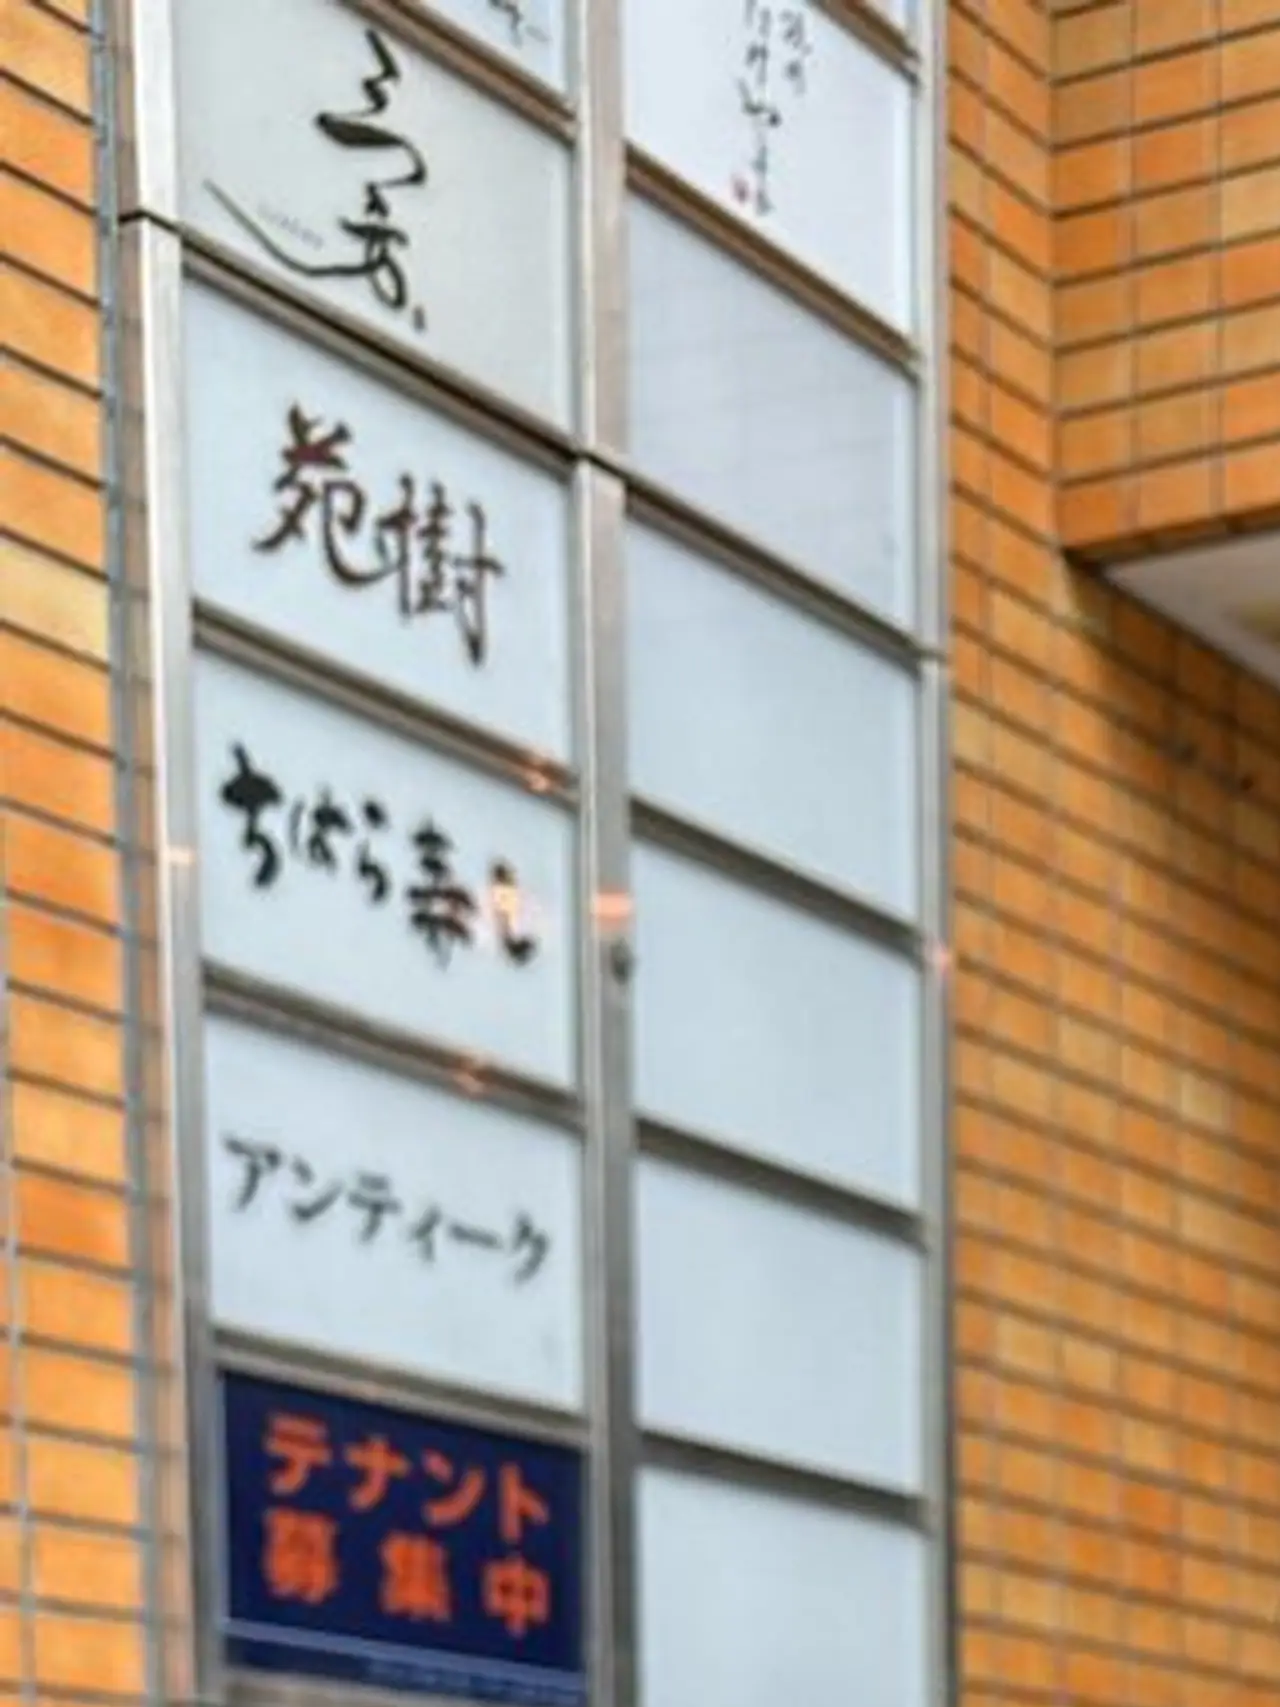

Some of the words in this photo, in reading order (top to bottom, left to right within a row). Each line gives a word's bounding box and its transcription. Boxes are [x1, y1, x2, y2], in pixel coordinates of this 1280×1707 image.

[222, 1132, 551, 1285] アンティーク
[264, 1411, 550, 1543] テナント
[263, 1507, 551, 1637] 募集中
